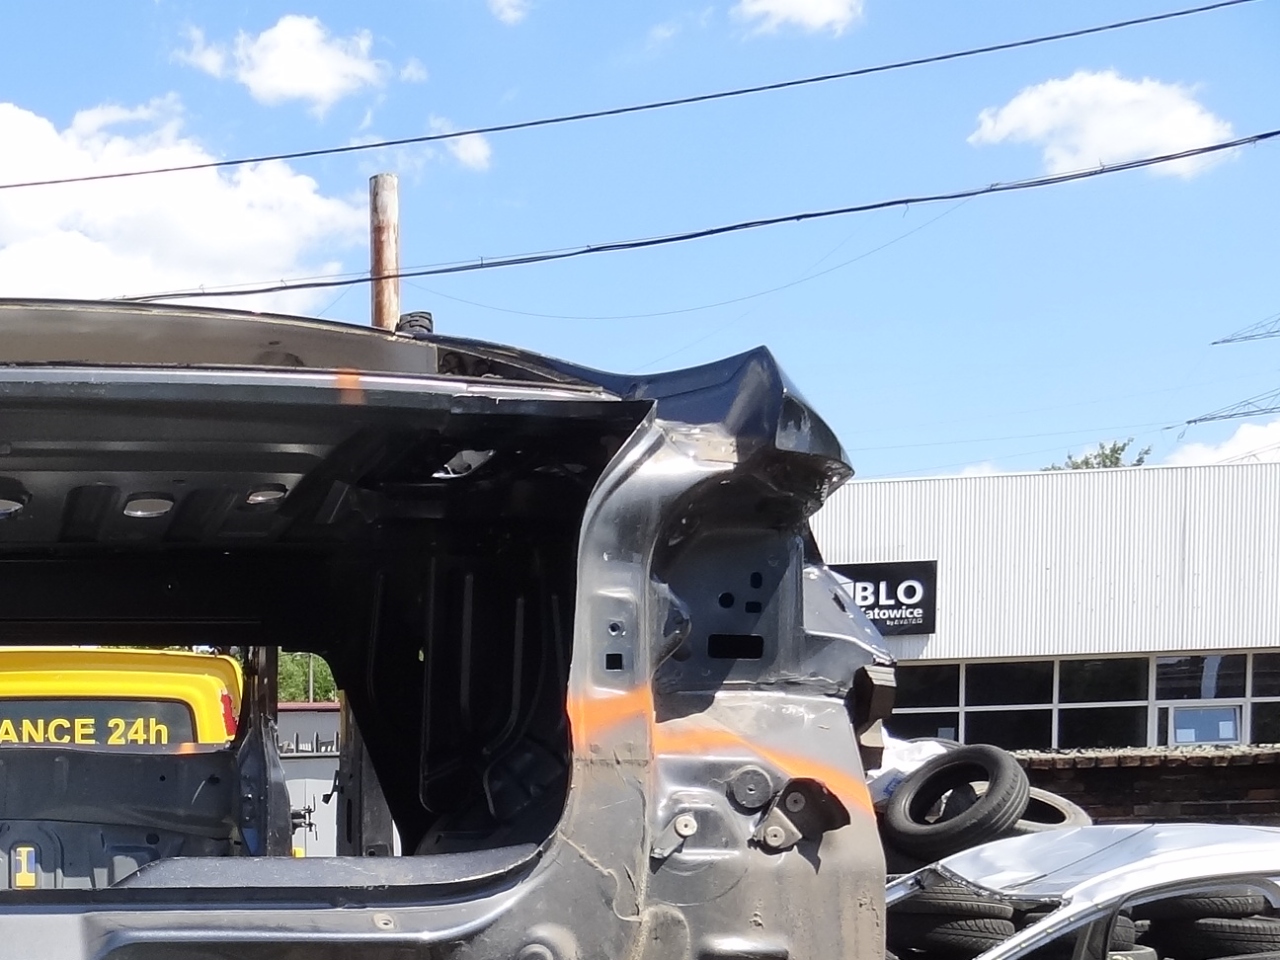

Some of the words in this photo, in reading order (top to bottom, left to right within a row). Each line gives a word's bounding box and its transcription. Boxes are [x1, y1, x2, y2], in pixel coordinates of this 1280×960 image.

[854, 580, 924, 606] BLO
[860, 605, 923, 619] atowice
[107, 718, 169, 744] 24h
